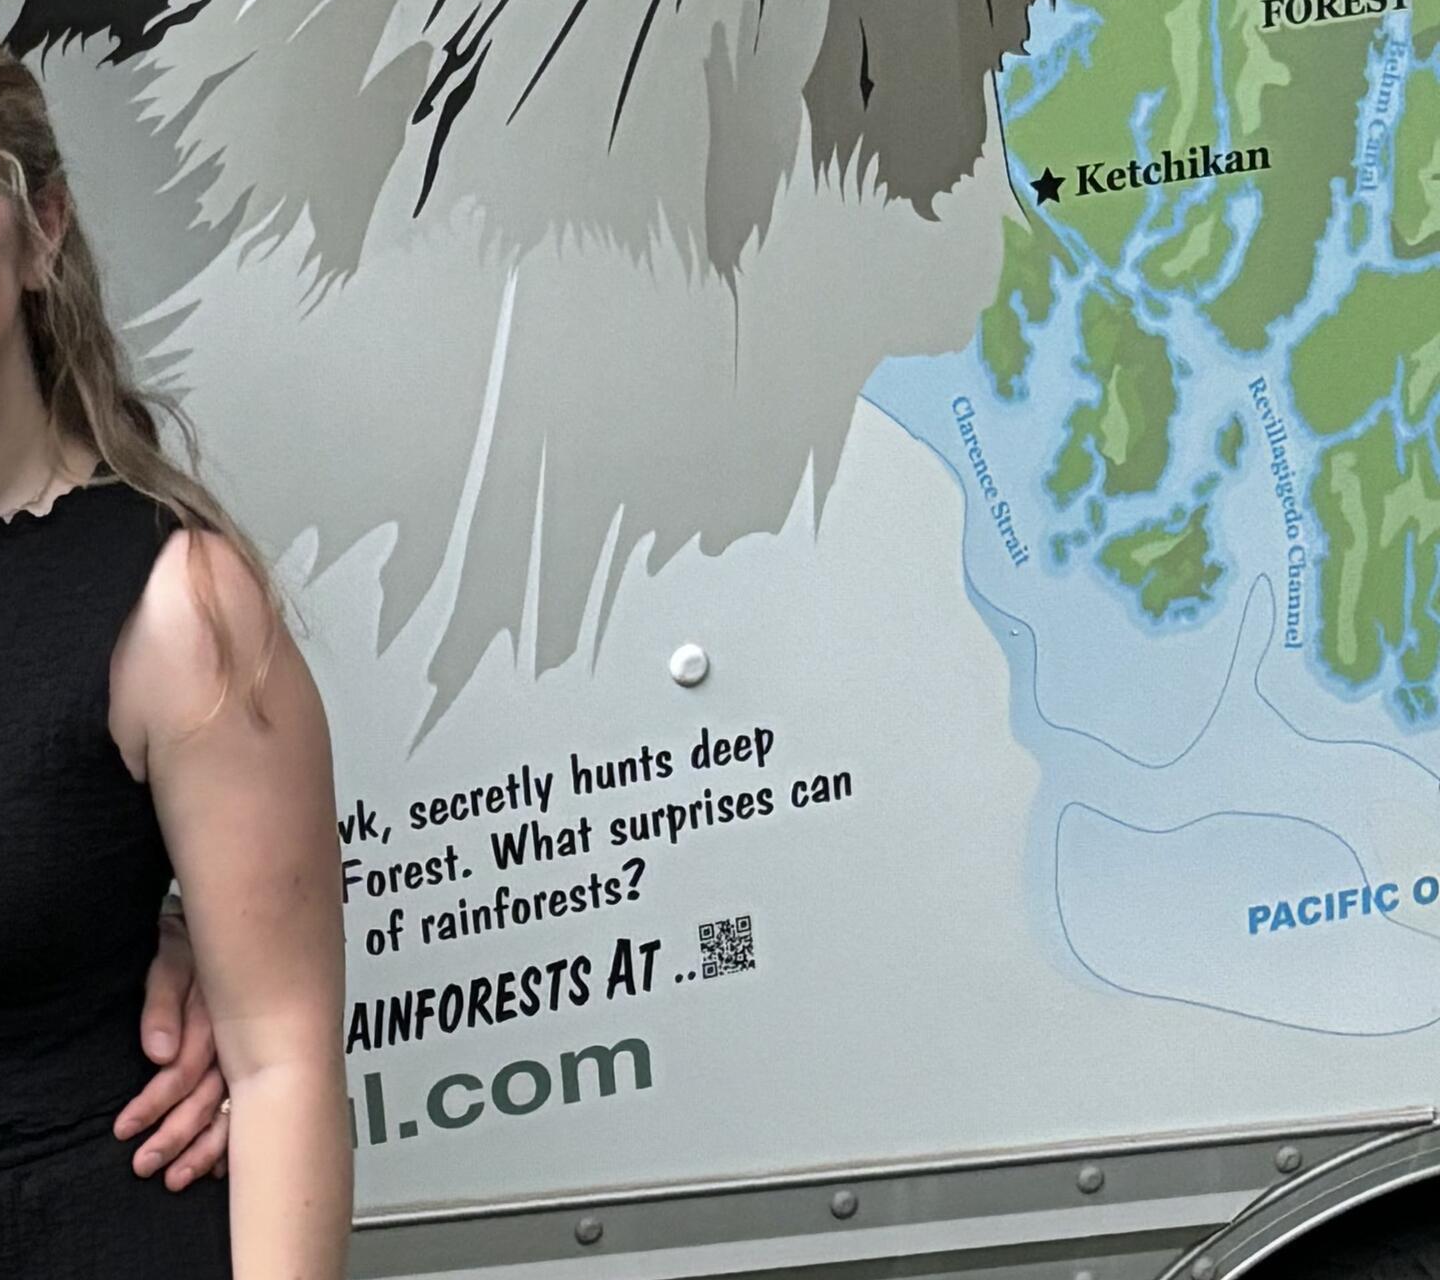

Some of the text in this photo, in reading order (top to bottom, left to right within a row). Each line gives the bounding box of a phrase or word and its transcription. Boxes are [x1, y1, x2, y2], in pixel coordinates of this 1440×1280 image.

[1074, 145, 1272, 196] Ketchikan
[951, 395, 1030, 568] Clarence Strait
[1248, 375, 1307, 650] Revillagigedo Channel
[409, 764, 554, 830] secretly
[571, 745, 673, 795] hunts
[691, 727, 774, 771] deep
[341, 770, 854, 904] Forest. What surprises can
[366, 857, 647, 956] of rainforests?
[1248, 883, 1400, 935] PACIFIC
[606, 938, 662, 999] AT
